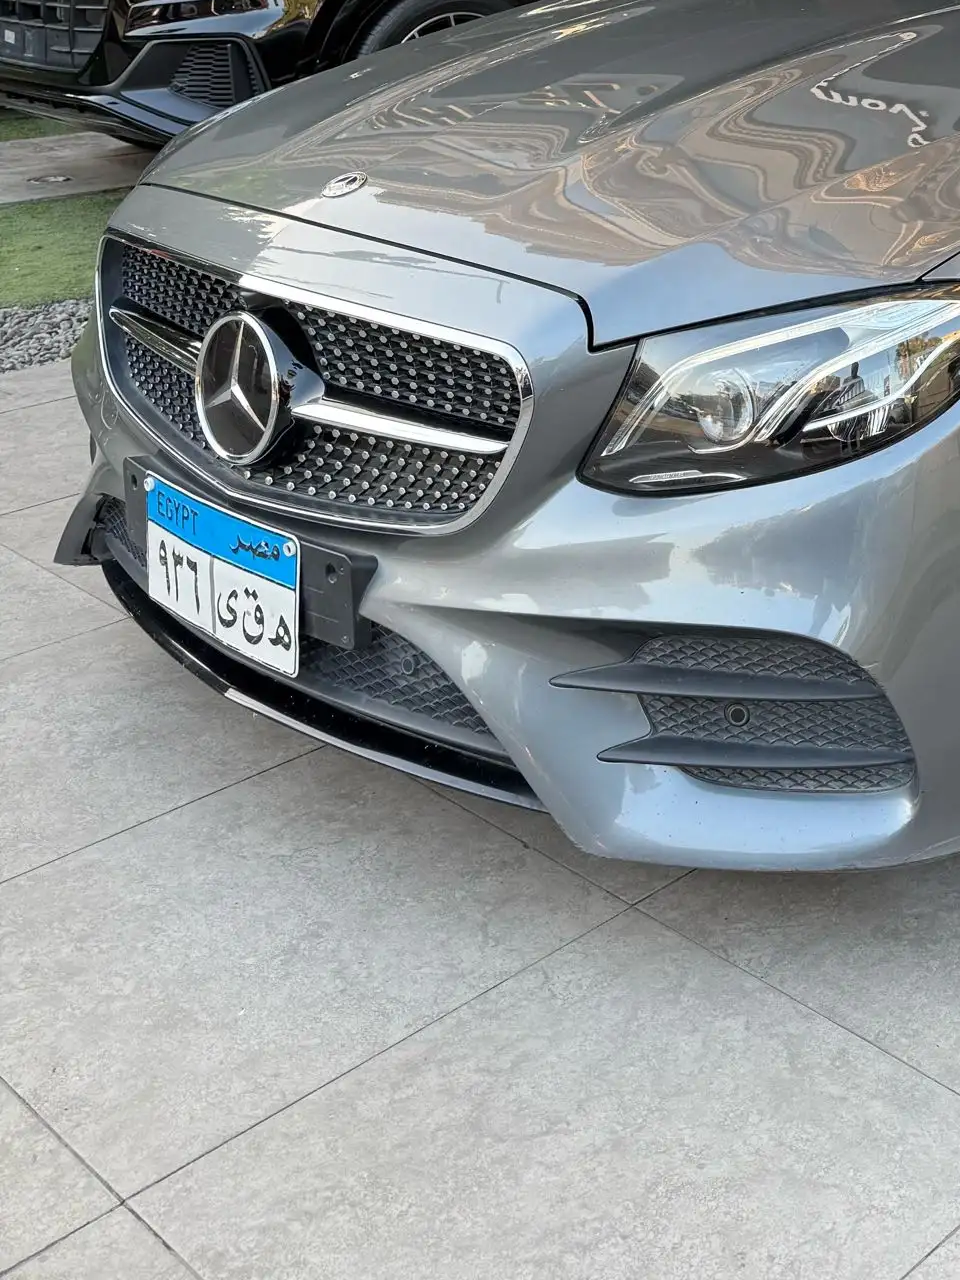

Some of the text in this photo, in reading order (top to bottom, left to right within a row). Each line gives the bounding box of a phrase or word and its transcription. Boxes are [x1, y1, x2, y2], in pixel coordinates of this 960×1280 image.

[156, 492, 199, 535] EGYPT
[229, 532, 281, 562] مصر
[158, 539, 200, 615] ٩٣٦
